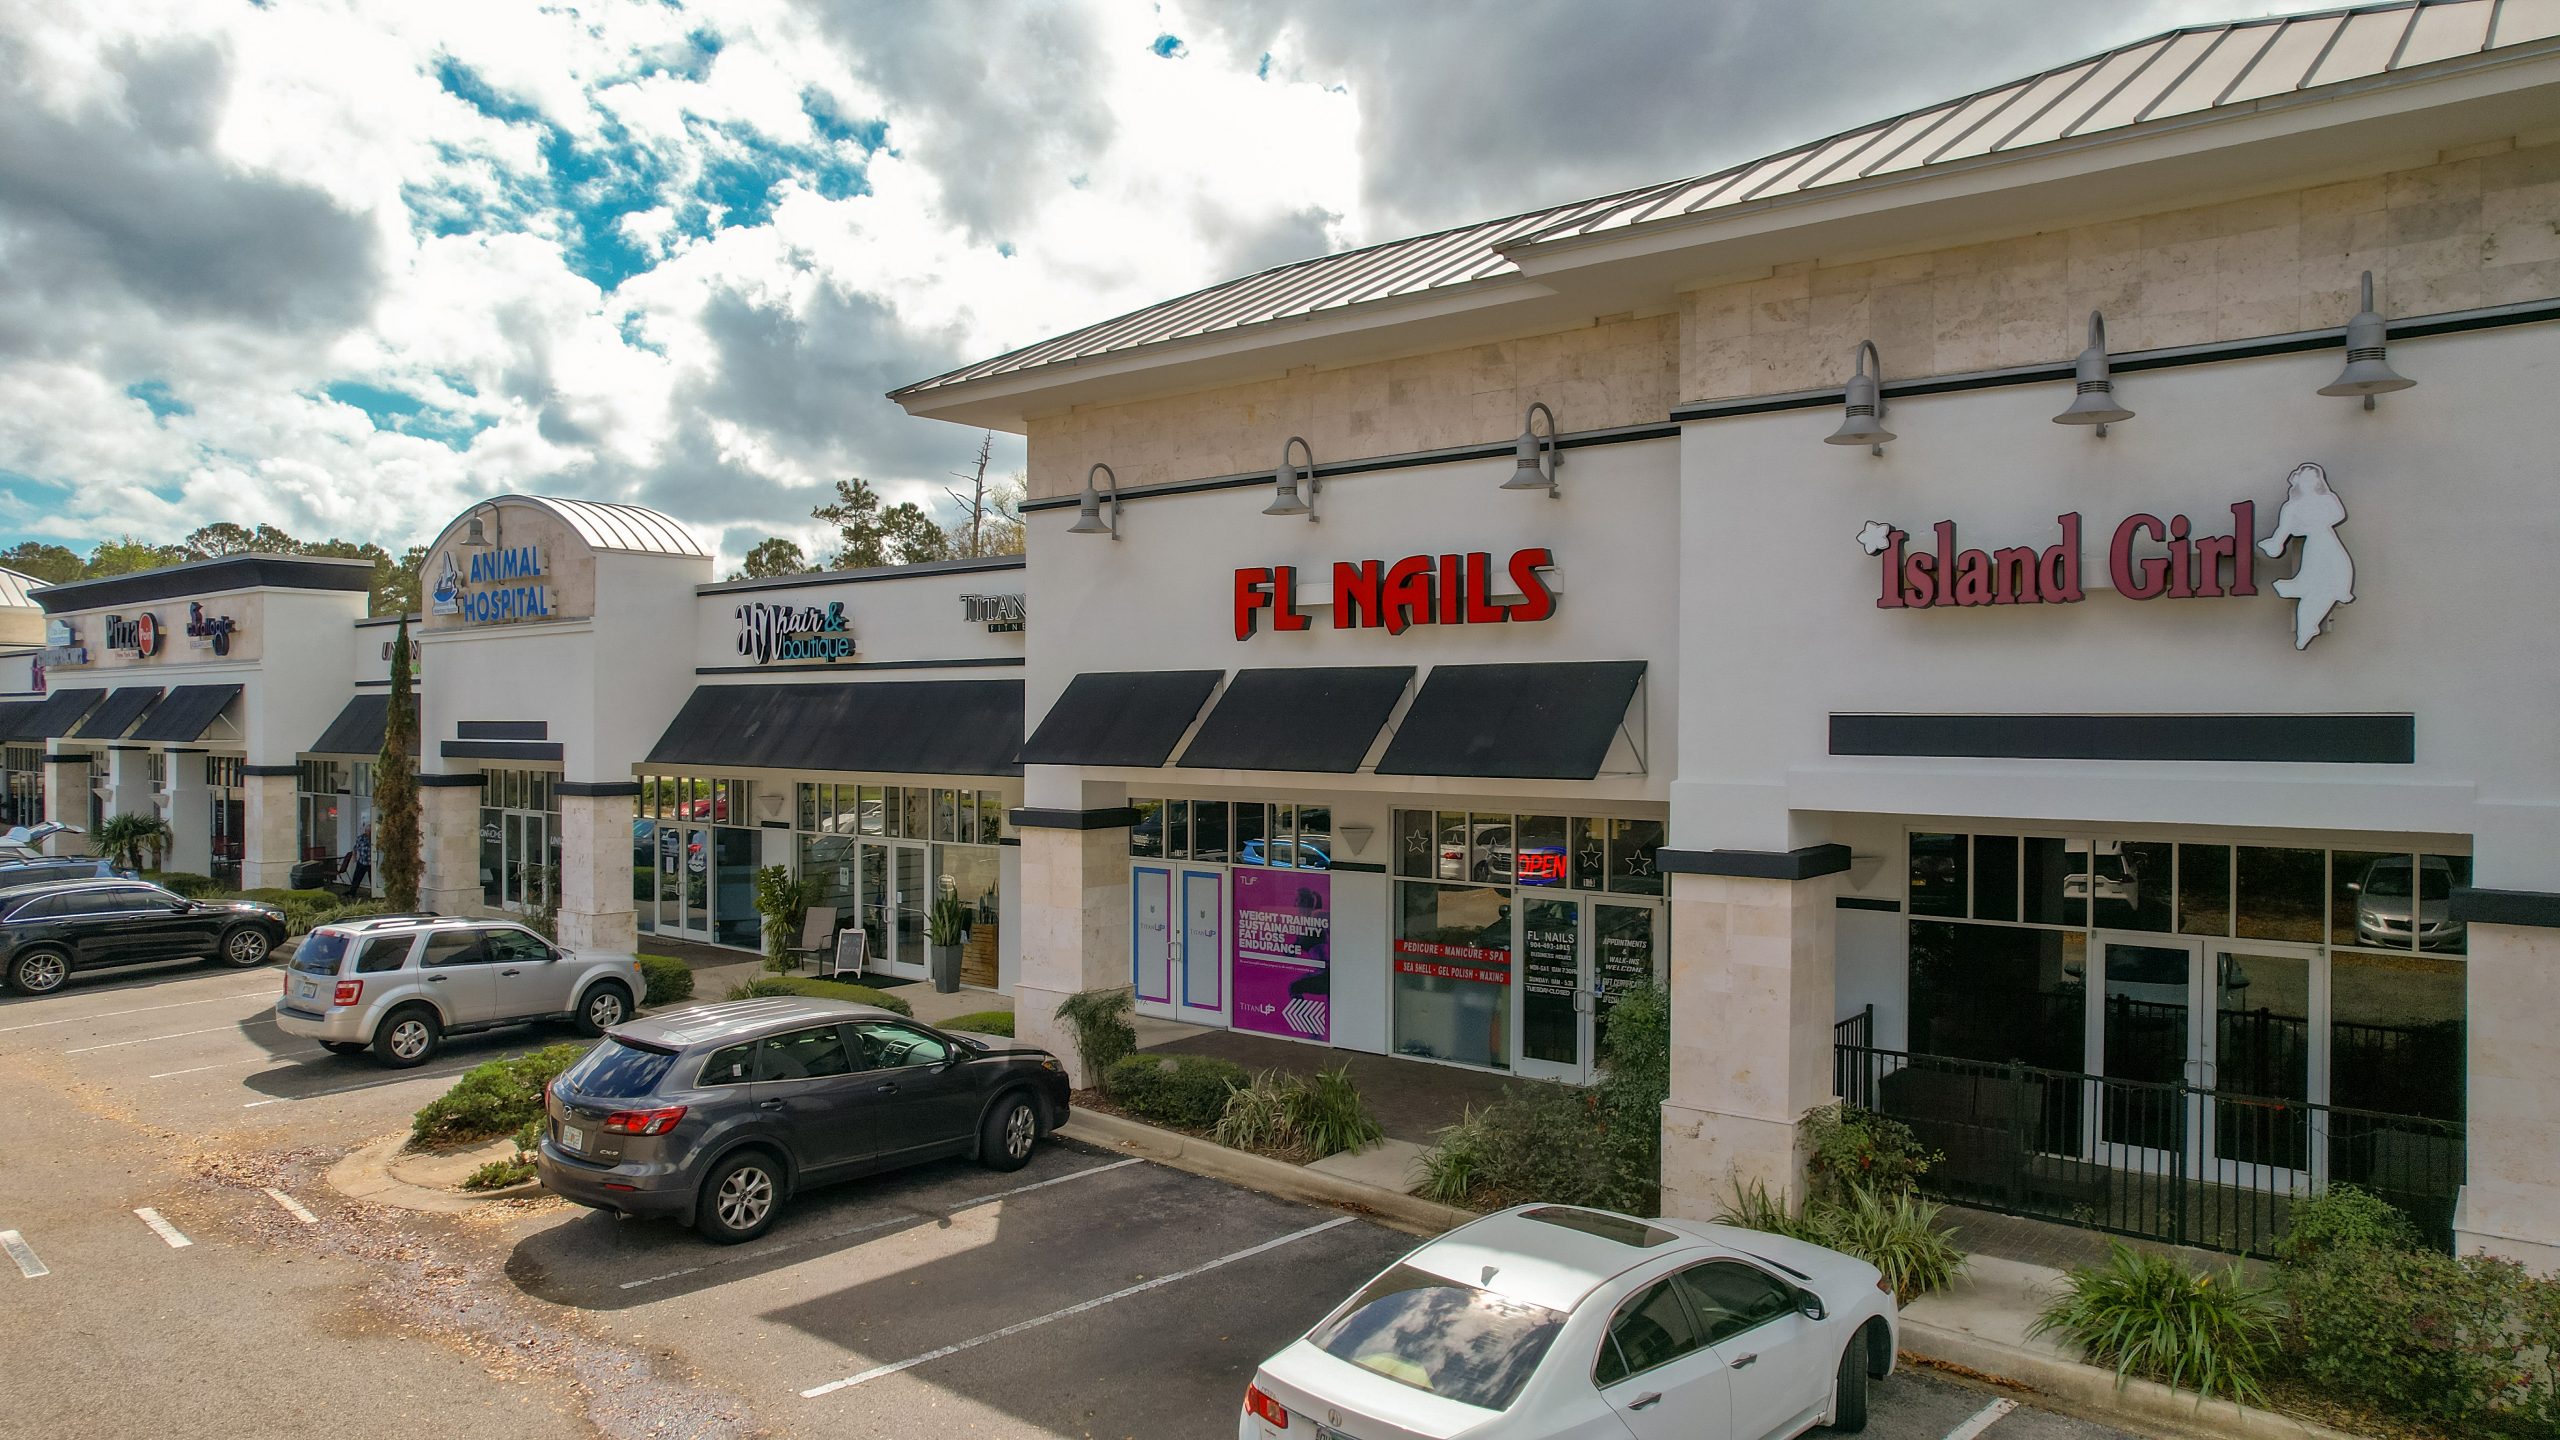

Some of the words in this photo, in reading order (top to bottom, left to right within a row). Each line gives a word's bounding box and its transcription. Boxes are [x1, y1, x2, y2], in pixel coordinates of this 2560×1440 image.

[470, 545, 541, 583] ANIMAL
[1877, 511, 2085, 609] Island
[2110, 500, 2258, 601] Girl
[463, 585, 548, 622] HOSPITAL
[1234, 566, 1312, 641] FL
[1333, 548, 1557, 636] NAILS
[959, 593, 1026, 622] TITAN
[777, 606, 823, 634] hair
[990, 623, 1026, 632] FITNE
[106, 615, 140, 649] Pizza
[783, 635, 850, 663] boutique
[1519, 853, 1567, 878] OPEN
[1239, 909, 1278, 922] WEIGHT
[1280, 914, 1329, 928] TRAINING
[1239, 920, 1322, 937] SUSTAINABILITY
[1239, 929, 1257, 940] FAT
[1260, 931, 1285, 943] LOSS
[1527, 930, 1540, 941] FL
[1545, 932, 1575, 943] NAILS
[1602, 937, 1648, 948] APPOINTMENTS
[1239, 939, 1302, 955] ENDURANCE
[1403, 941, 1438, 954] PEDICURE
[1445, 946, 1483, 959] MANICURE
[1489, 950, 1504, 961] SPA
[1605, 964, 1644, 973] WELCOME
[1609, 956, 1640, 965] WALK-INS
[1403, 962, 1413, 972] SEA
[1415, 963, 1432, 974] SHELL
[1438, 966, 1449, 976] GEL
[1451, 967, 1473, 979] POLISH
[1479, 971, 1504, 982] WAXING
